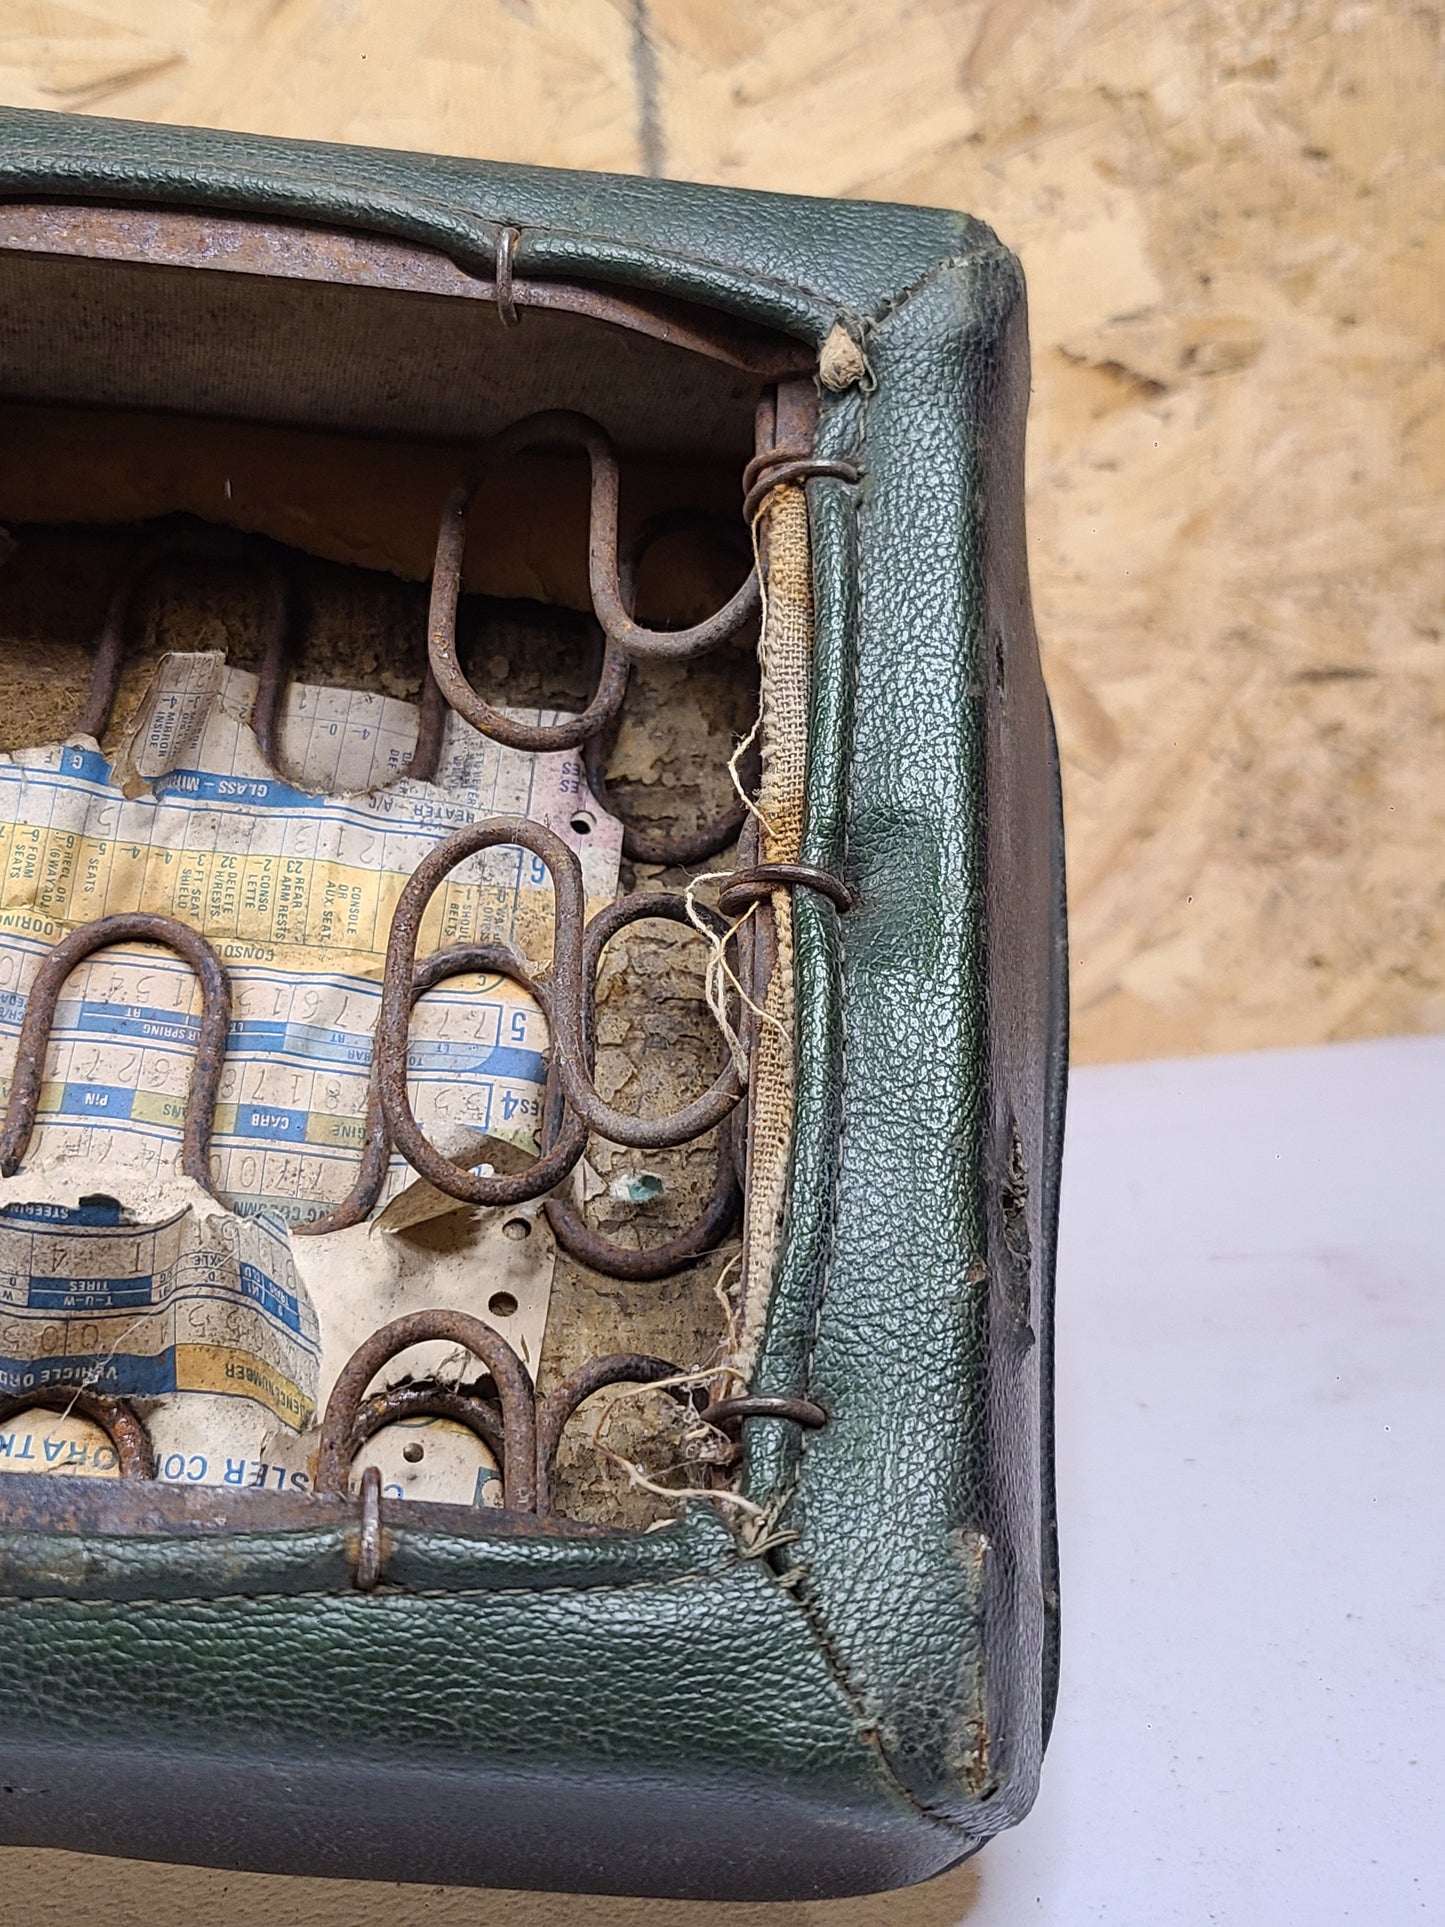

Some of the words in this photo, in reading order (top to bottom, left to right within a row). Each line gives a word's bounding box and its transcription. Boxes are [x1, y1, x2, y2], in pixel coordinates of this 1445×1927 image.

[149, 711, 168, 749] INSIDE
[158, 711, 176, 758] MIRROR
[218, 780, 268, 798] GLASS
[98, 806, 115, 836] 5
[412, 802, 476, 825] HEATER
[10, 843, 26, 879] SEATS
[24, 846, 39, 879] FOAM
[84, 858, 99, 894] SEATS
[221, 856, 238, 870] 32
[287, 860, 304, 875] 23
[530, 857, 545, 884] 6
[177, 869, 193, 910] SHIELD
[195, 870, 204, 883] FT
[244, 873, 258, 910] LETTE
[281, 876, 293, 902] ARM
[56, 888, 67, 904] OR
[188, 889, 202, 920] SEAT
[222, 872, 238, 915] DELETE
[292, 877, 305, 909] REAR
[324, 880, 337, 905] AUX
[338, 884, 349, 900] OR
[275, 905, 288, 940] RESTS
[346, 887, 362, 936] CONSOLE
[447, 902, 460, 937] BELTS
[125, 1006, 141, 1018] RT
[333, 995, 348, 1028] 7
[141, 1024, 186, 1040] SPRING
[229, 1022, 245, 1033] LT
[330, 1033, 347, 1044] RT
[511, 1012, 526, 1042] 5
[346, 1050, 371, 1062] BAR
[435, 1043, 450, 1054] LT
[251, 1069, 265, 1100] 7
[501, 1090, 519, 1121] 4
[250, 1113, 290, 1130] CARB
[69, 1280, 110, 1292] TIRES
[224, 1362, 276, 1393] NUMBER
